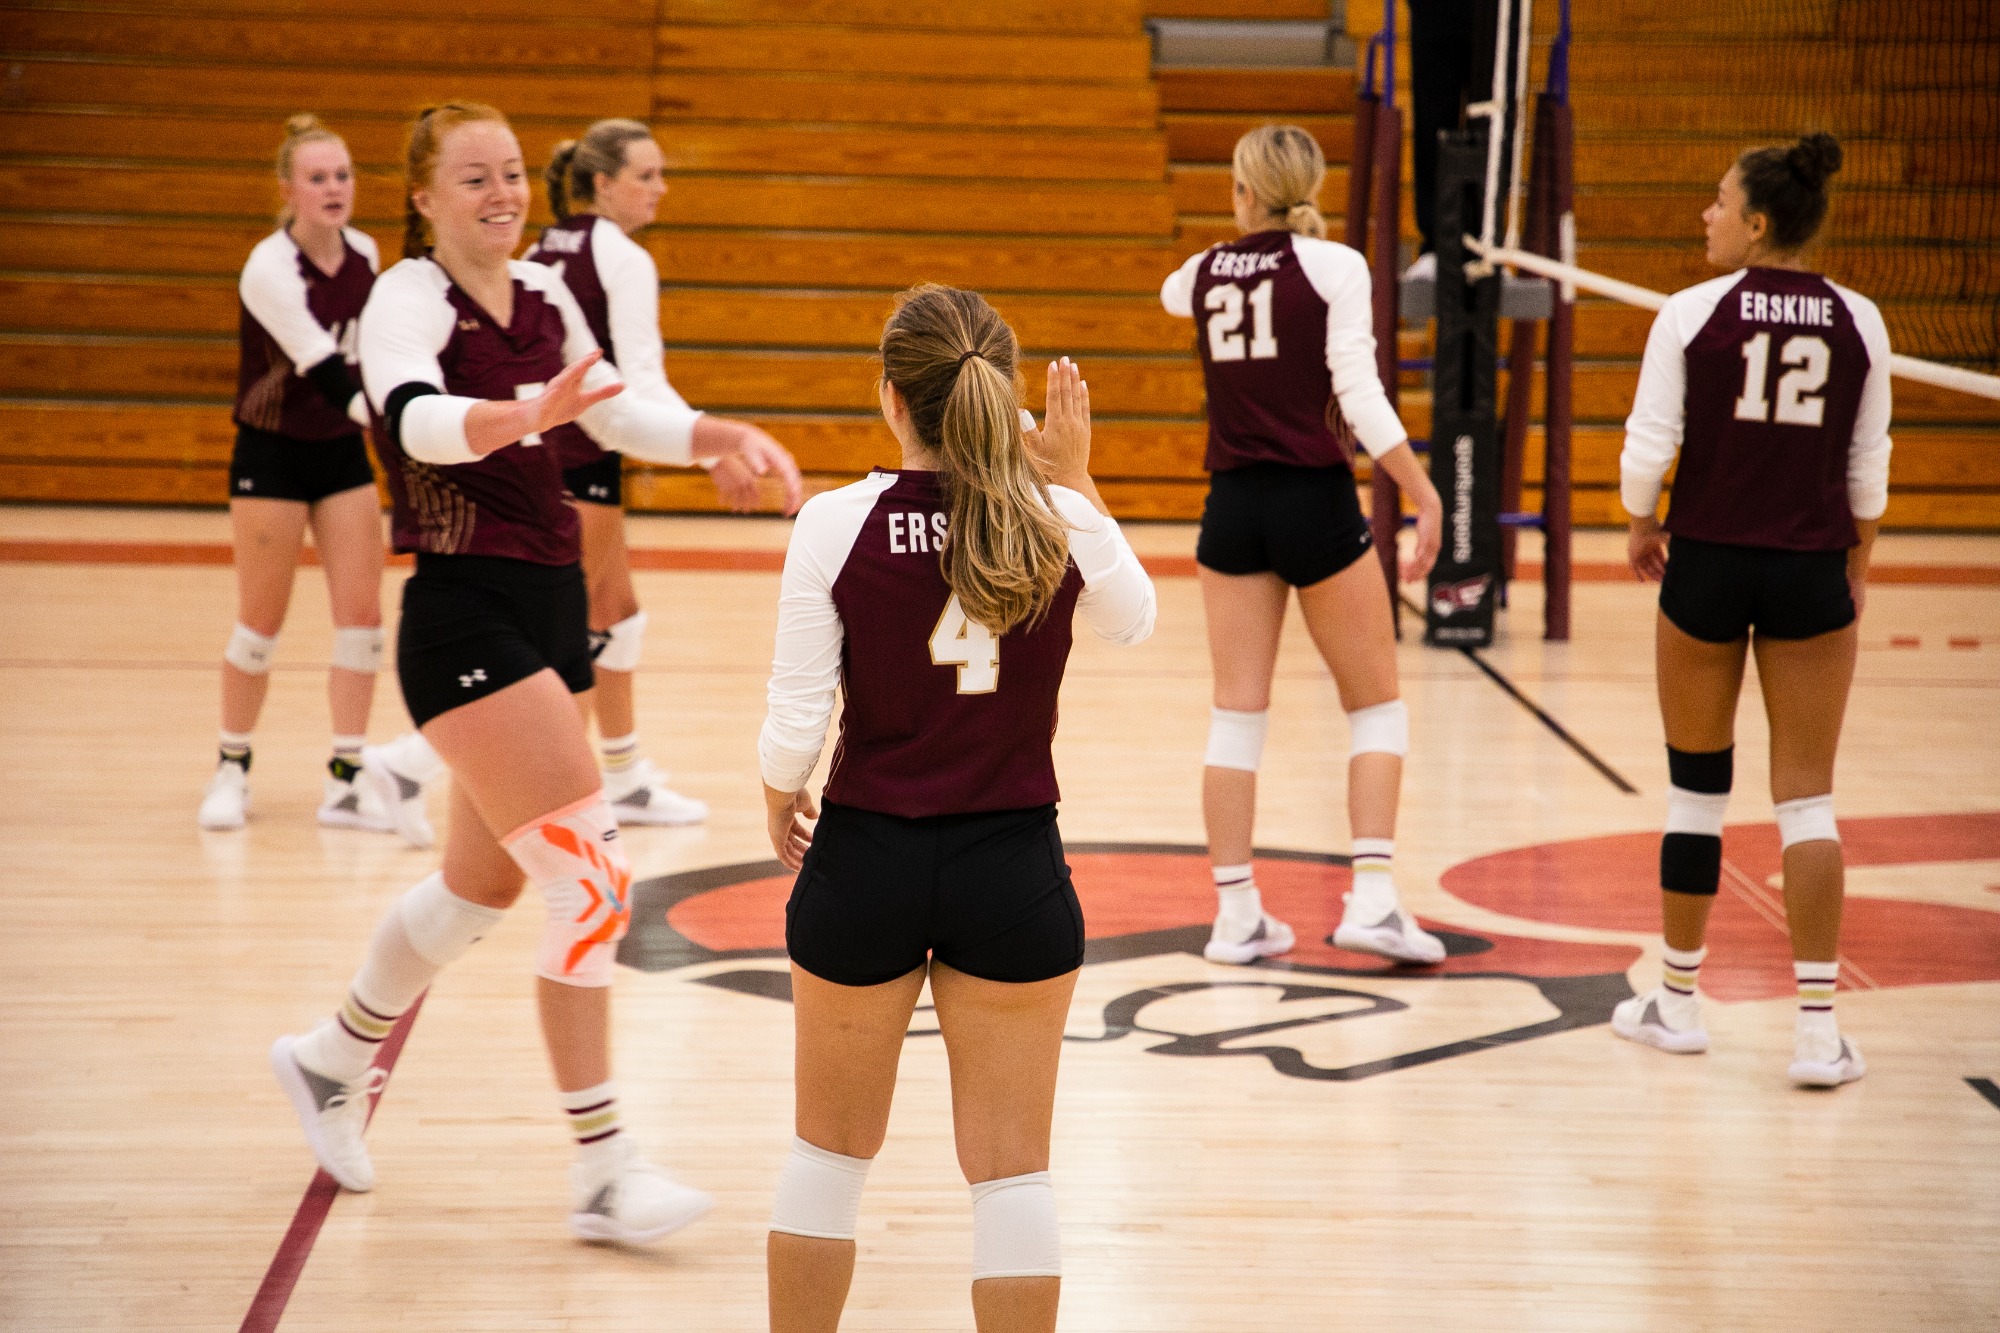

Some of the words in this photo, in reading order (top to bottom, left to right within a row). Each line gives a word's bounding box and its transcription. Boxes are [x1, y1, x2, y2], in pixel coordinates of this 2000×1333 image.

[1204, 279, 1278, 361] 21
[1740, 291, 1834, 327] ERSKINE
[1734, 331, 1831, 427] 12
[888, 512, 951, 553] ERS
[928, 590, 1000, 694] 4
